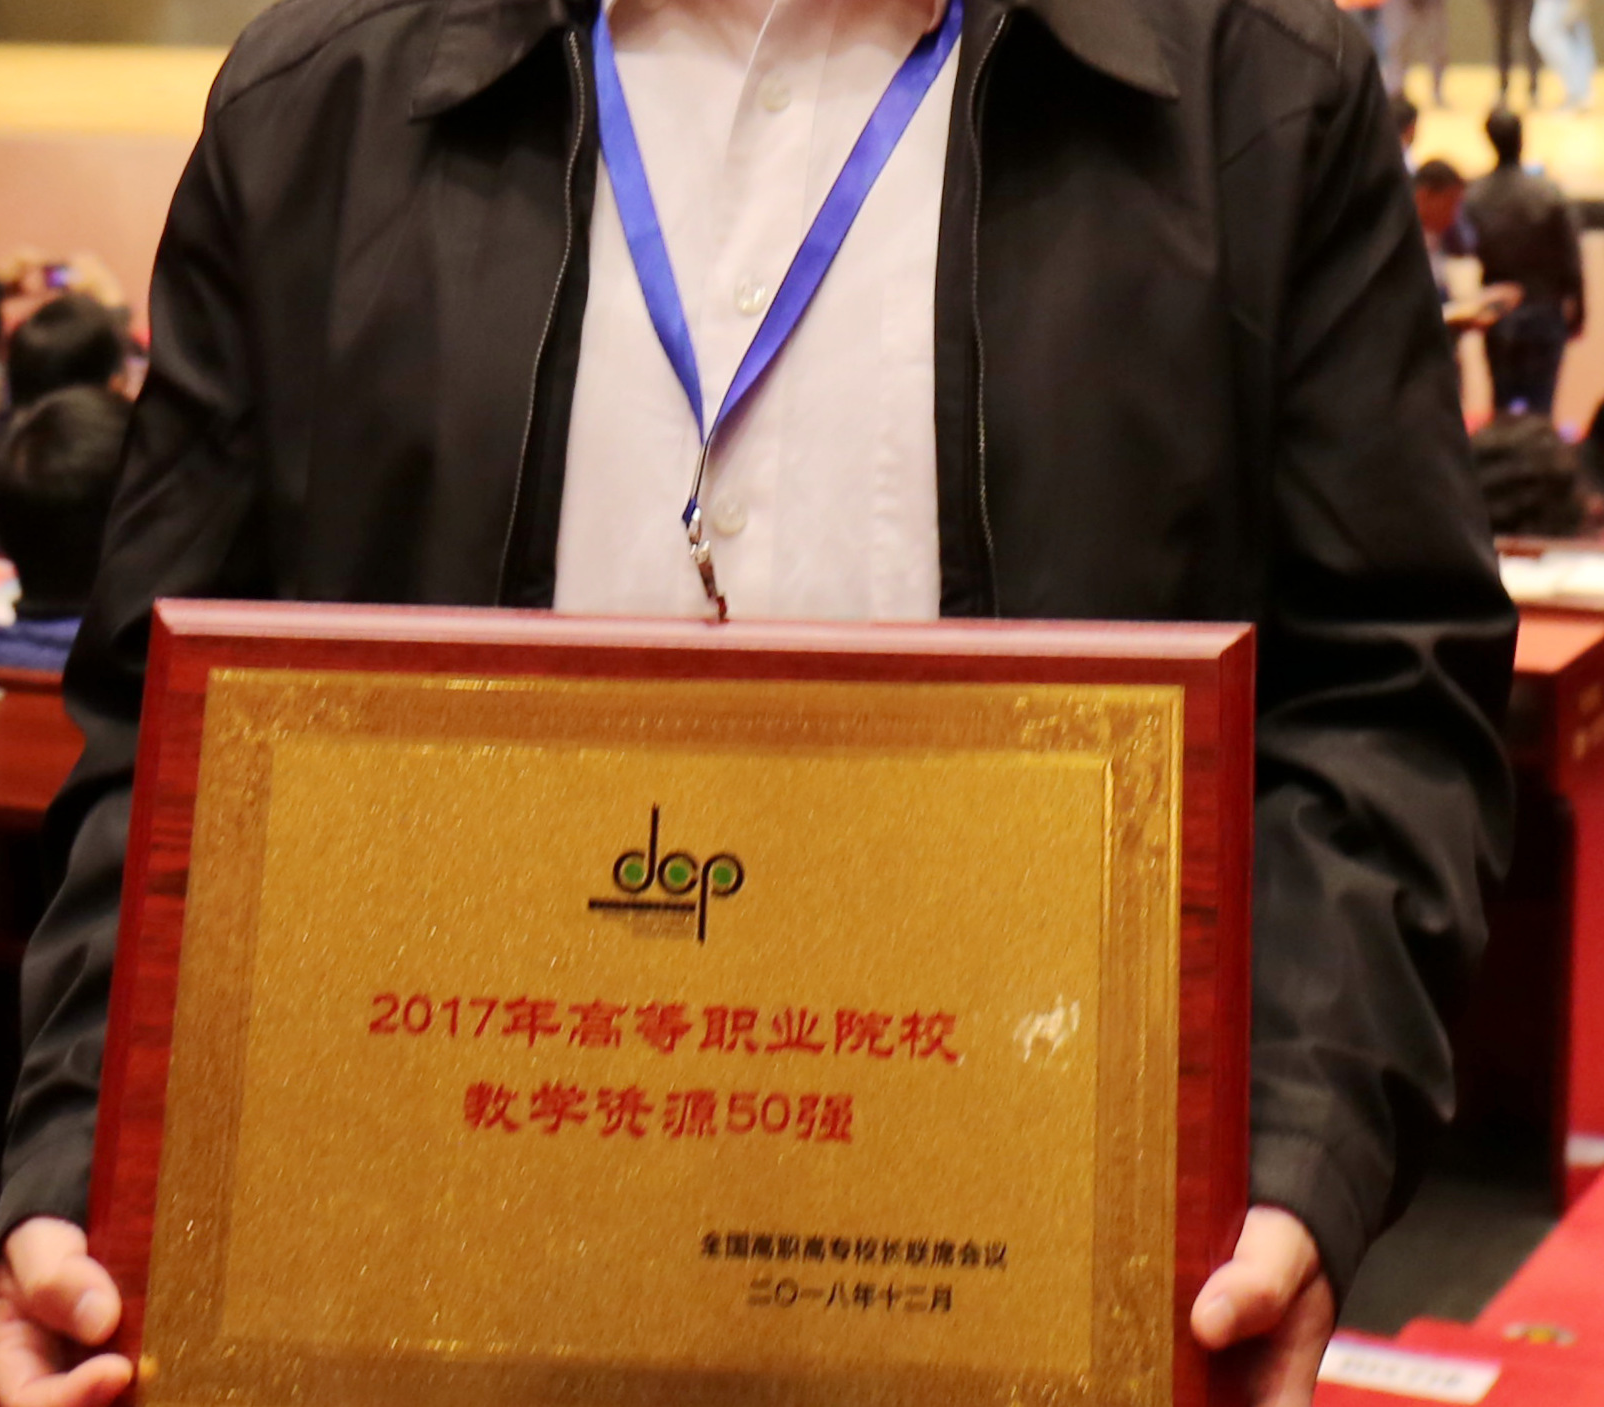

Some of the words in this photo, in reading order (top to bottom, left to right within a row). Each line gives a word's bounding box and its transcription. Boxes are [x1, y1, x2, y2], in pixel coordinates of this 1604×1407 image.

[367, 992, 959, 1065] 2017年高等职业院校
[462, 1078, 854, 1145] 教学资源50强
[701, 1229, 1008, 1271] 全国高职高专校长联席会议
